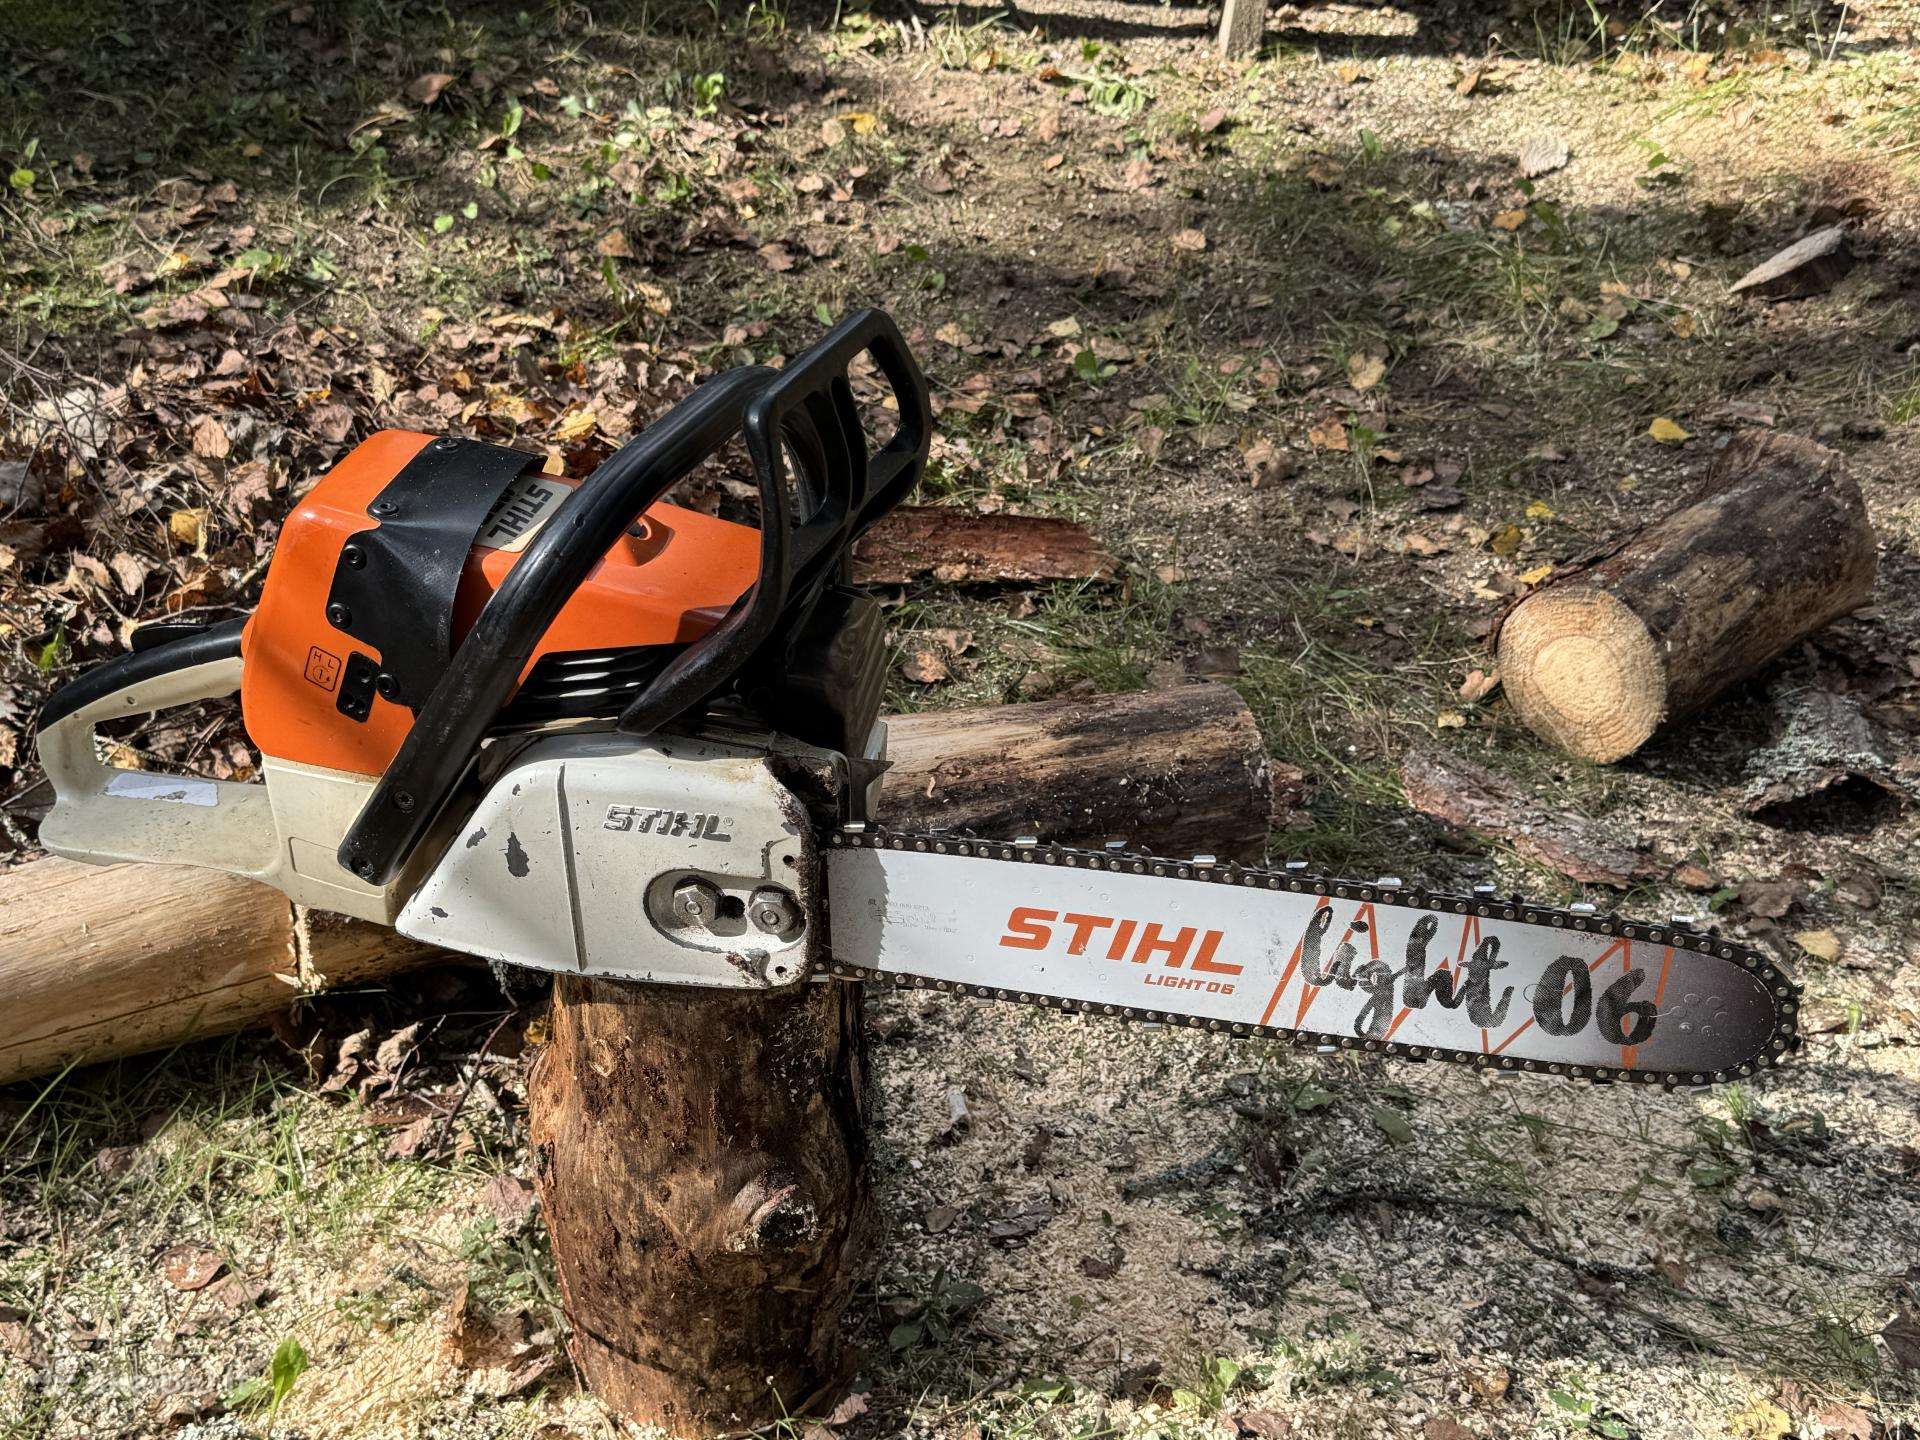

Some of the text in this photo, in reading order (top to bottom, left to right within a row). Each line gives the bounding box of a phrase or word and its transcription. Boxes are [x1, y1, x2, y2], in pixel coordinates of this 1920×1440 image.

[487, 483, 554, 538] STIHL
[313, 650, 335, 669] H L
[603, 803, 732, 843] STIHL
[998, 906, 1245, 976] STIHL
[1300, 905, 1659, 1046] light 06
